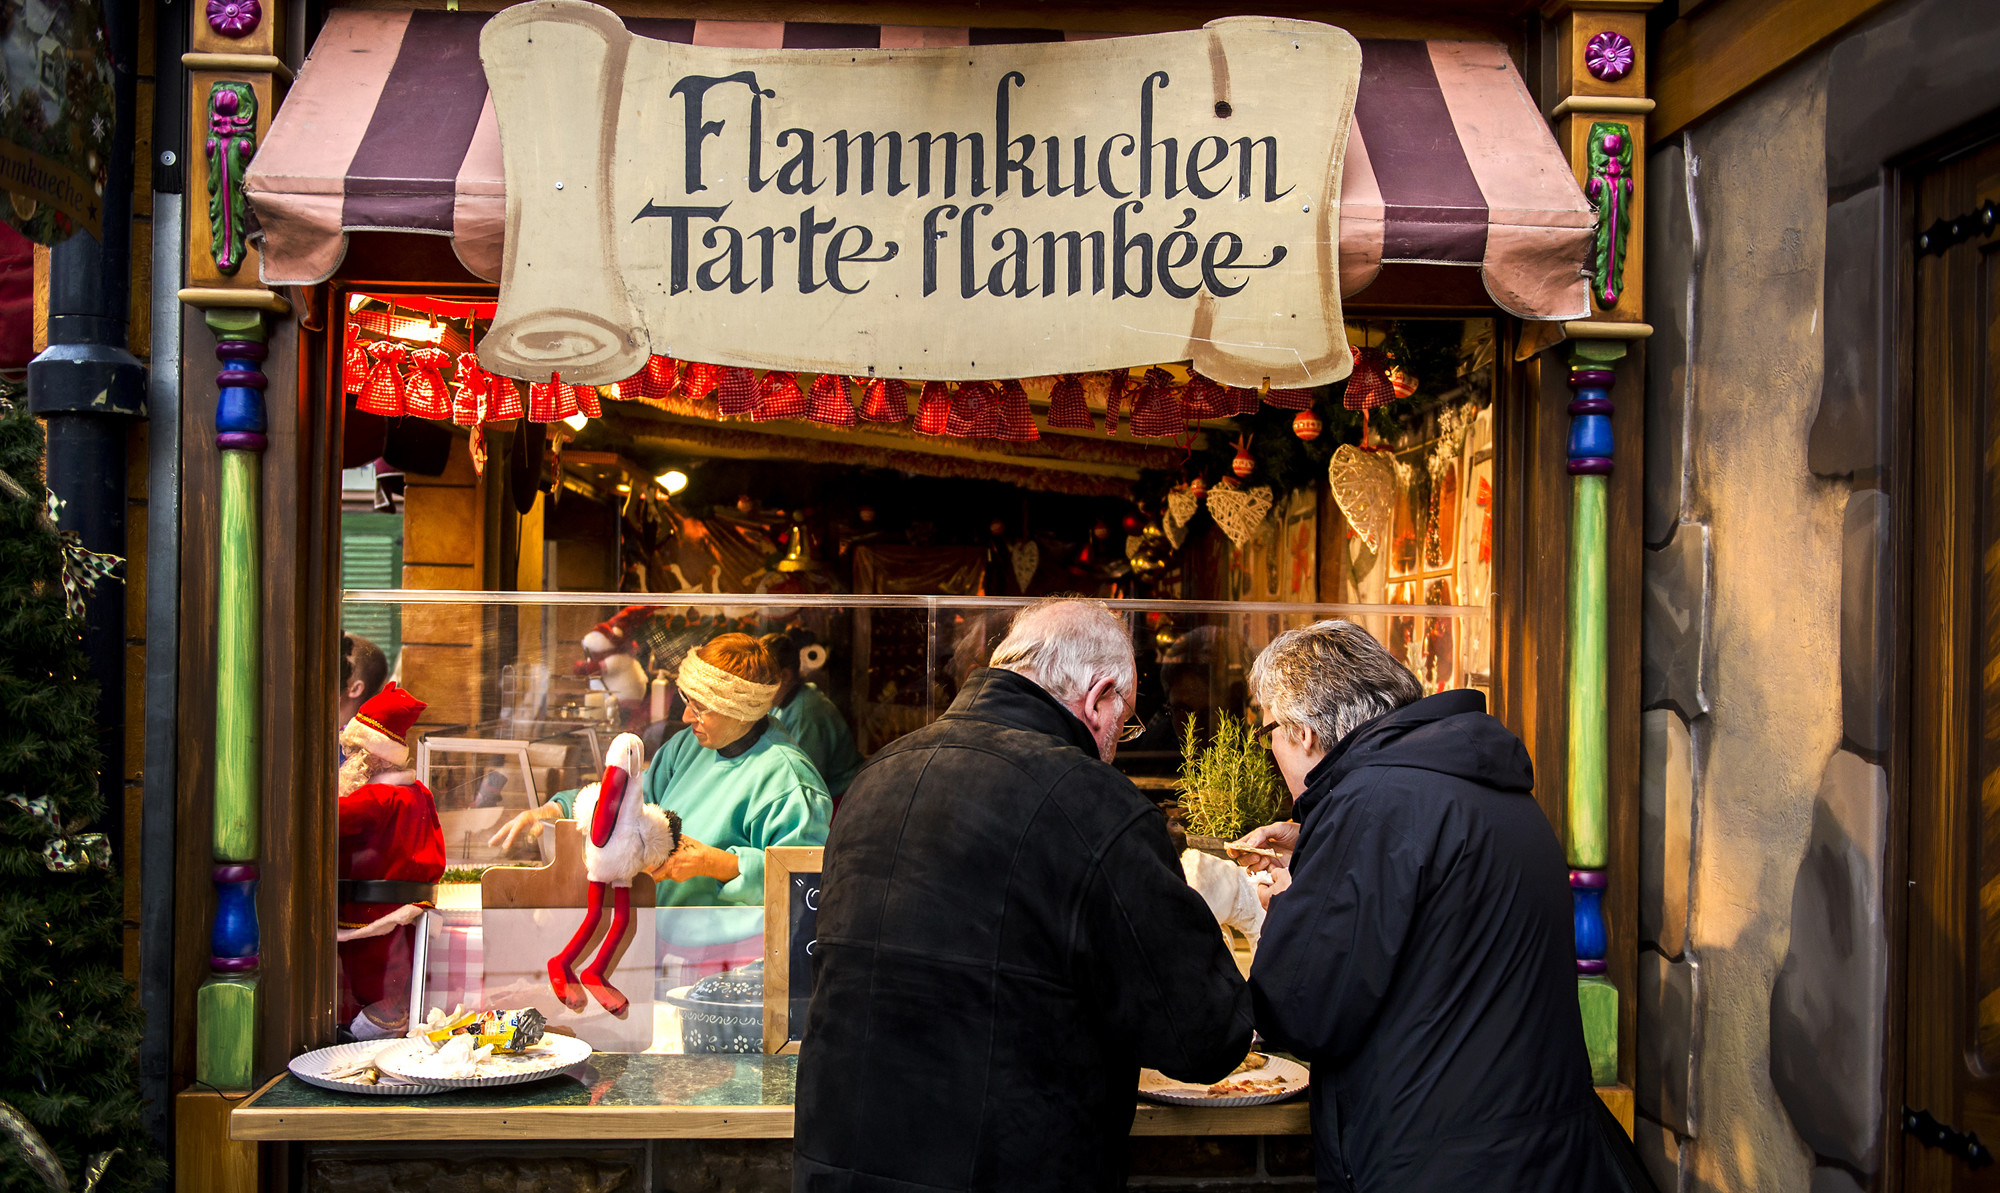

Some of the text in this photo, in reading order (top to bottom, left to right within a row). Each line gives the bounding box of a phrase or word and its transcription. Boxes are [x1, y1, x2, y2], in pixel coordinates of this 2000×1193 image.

[669, 71, 1296, 202] Flammkuchen
[631, 198, 1287, 300] Tarte flambée
